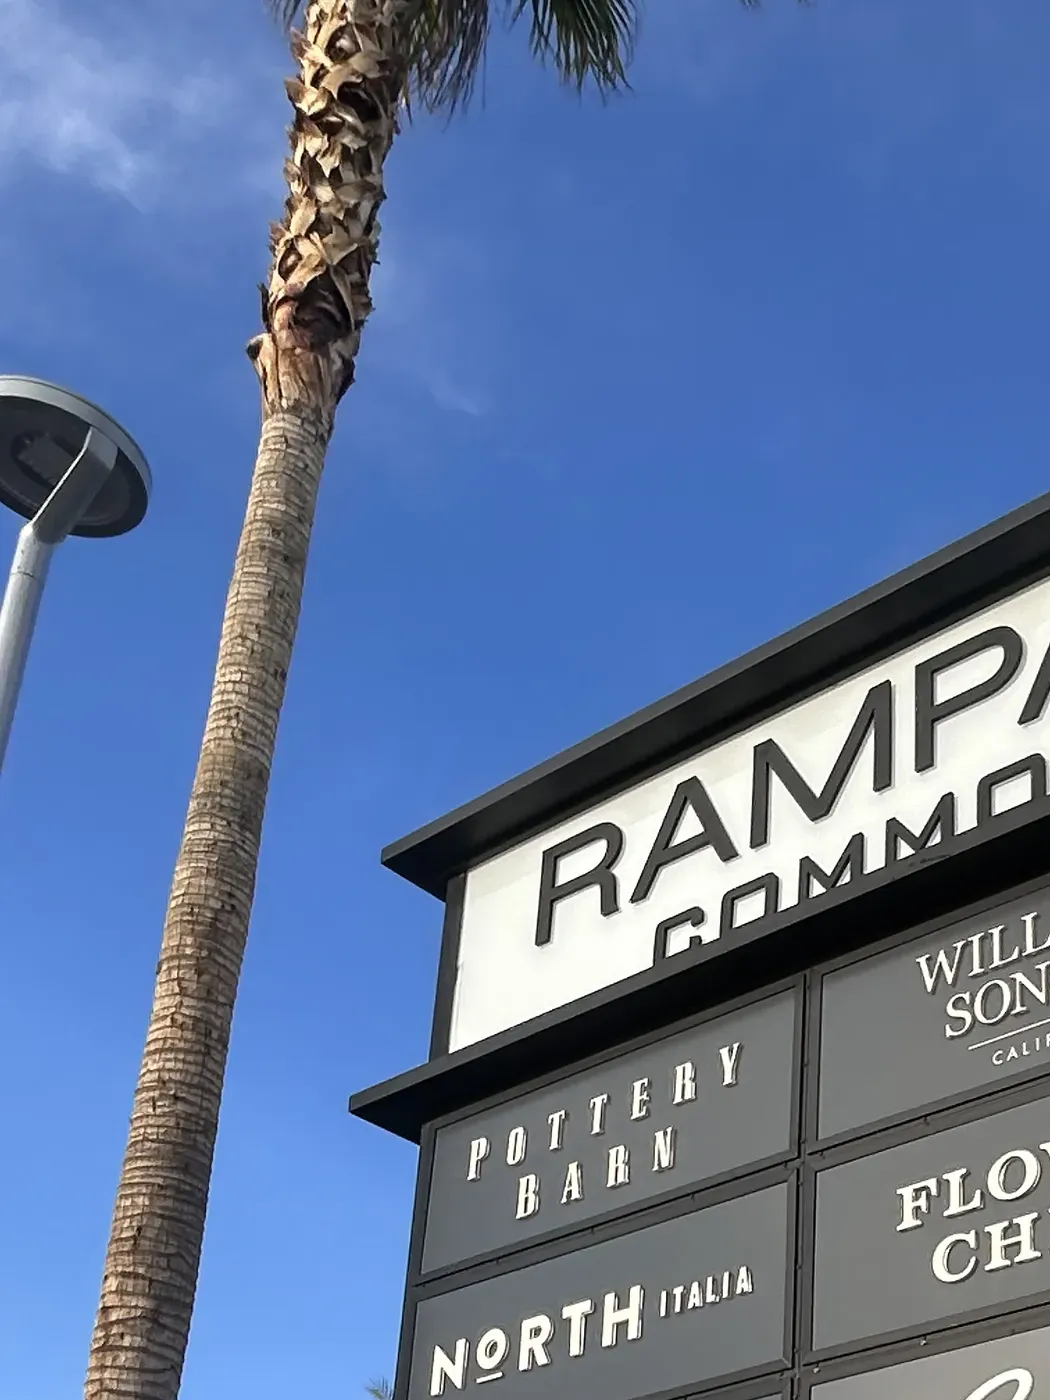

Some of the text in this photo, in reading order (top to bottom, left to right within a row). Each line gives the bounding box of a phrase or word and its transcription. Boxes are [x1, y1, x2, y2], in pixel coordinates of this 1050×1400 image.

[466, 1042, 742, 1181] POTTERY
[515, 1126, 675, 1220] BARN
[429, 1265, 753, 1396] NORTH ITALIA
